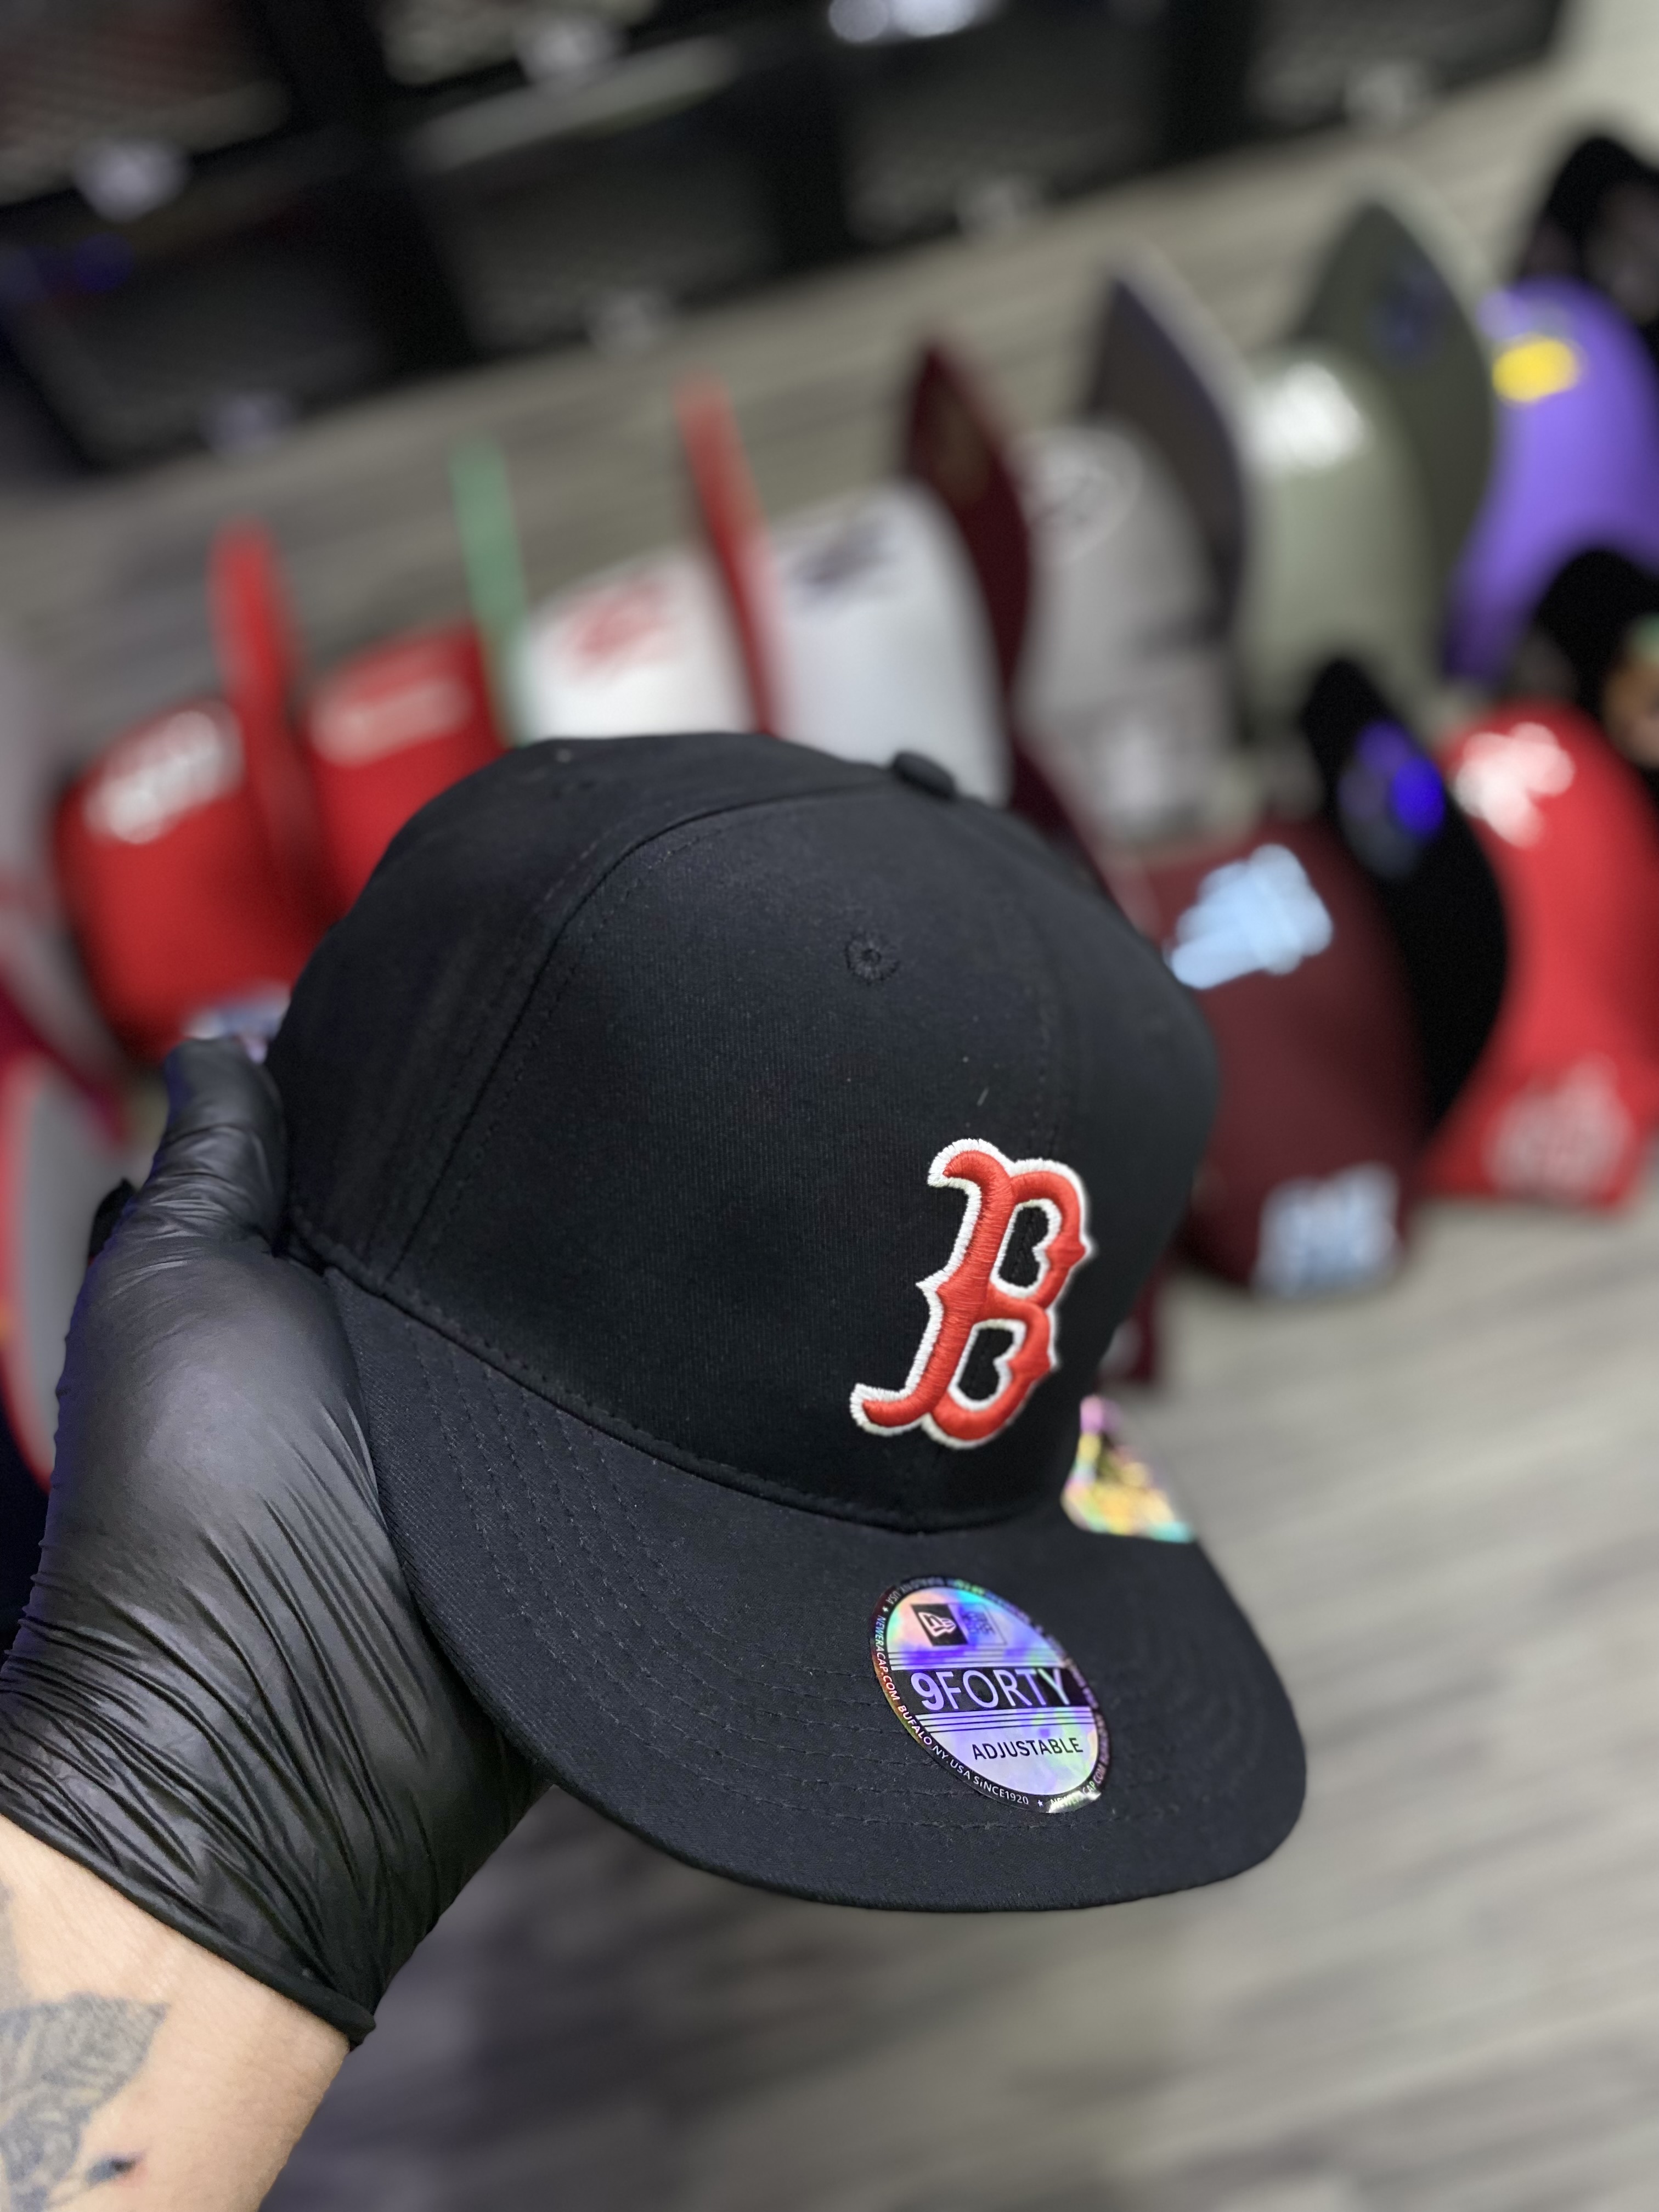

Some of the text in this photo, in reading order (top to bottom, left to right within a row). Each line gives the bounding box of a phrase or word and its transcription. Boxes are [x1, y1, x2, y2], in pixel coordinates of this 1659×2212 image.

[850, 1138, 1096, 1449] B
[911, 1668, 1070, 1711] 9FORTY
[898, 1705, 932, 1745] BUFALO
[972, 1737, 1084, 1760] ADJUSTABLE
